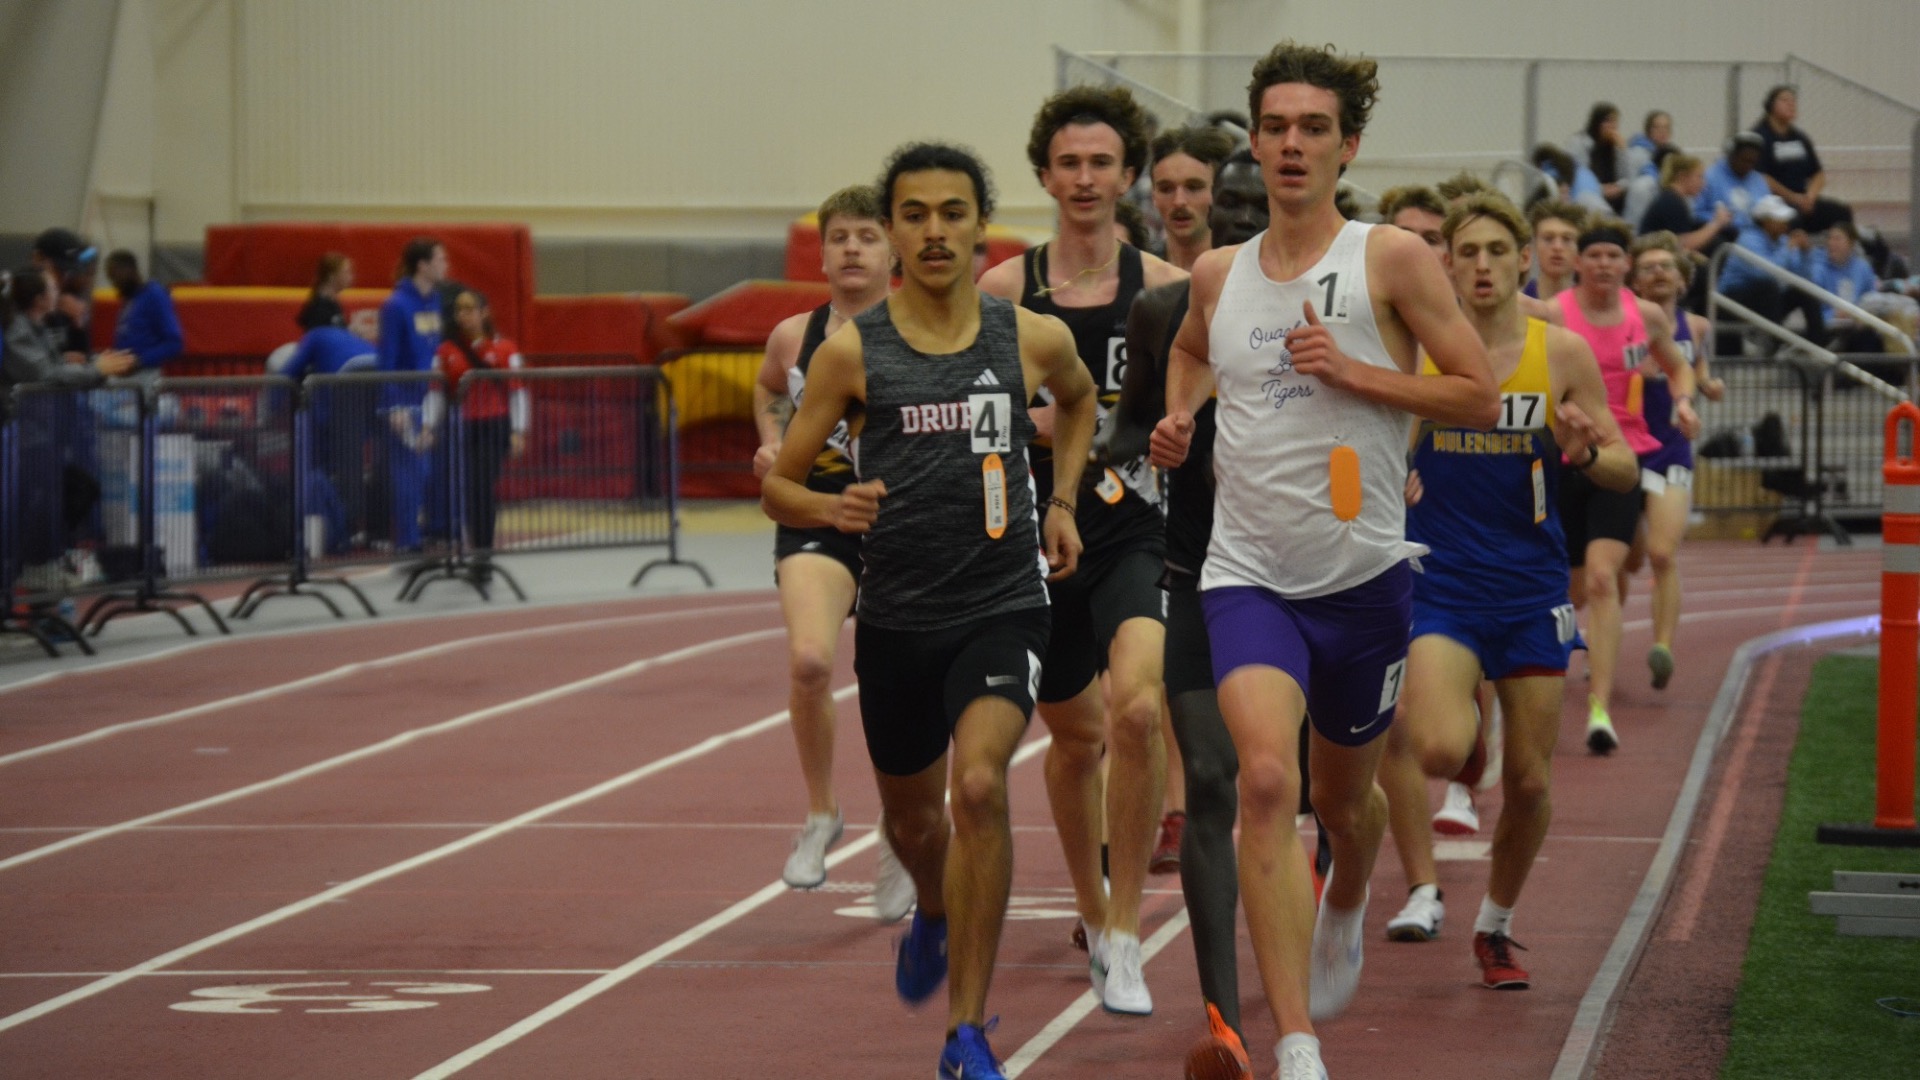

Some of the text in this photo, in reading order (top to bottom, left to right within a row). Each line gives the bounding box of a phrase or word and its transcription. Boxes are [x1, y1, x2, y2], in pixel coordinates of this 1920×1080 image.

[1317, 272, 1338, 317] 1
[1260, 378, 1315, 409] Tigers
[1501, 394, 1539, 427] 17
[974, 401, 999, 447] 4
[1432, 430, 1533, 455] MULERIDERS
[1389, 663, 1403, 703] 1
